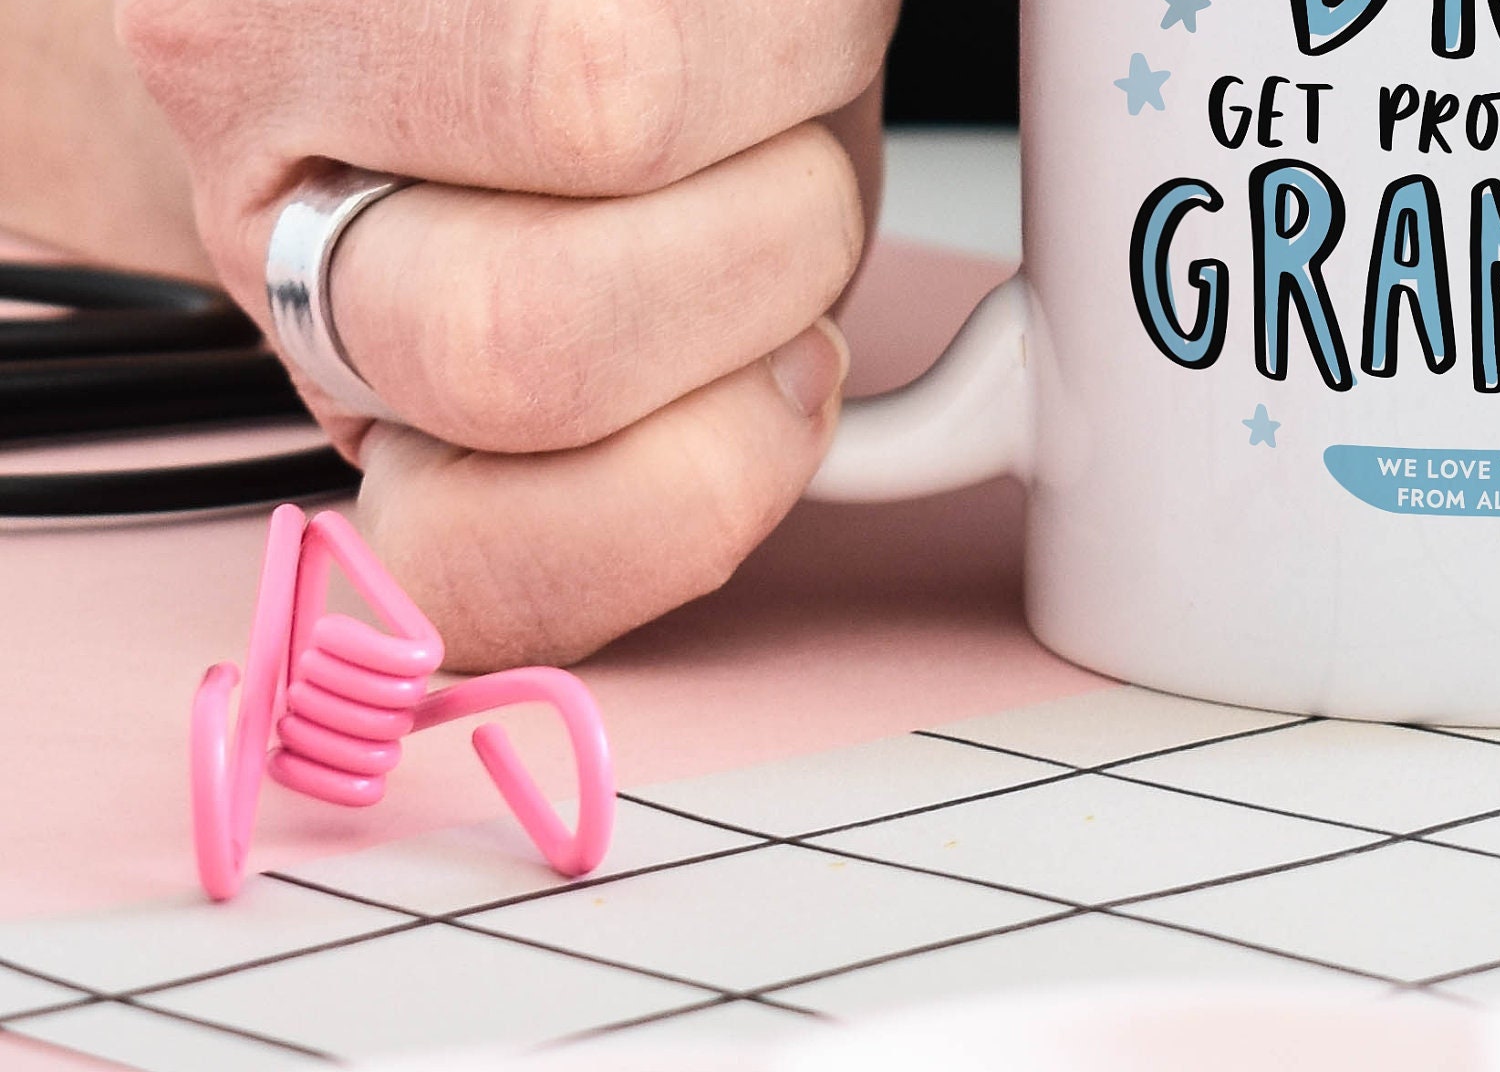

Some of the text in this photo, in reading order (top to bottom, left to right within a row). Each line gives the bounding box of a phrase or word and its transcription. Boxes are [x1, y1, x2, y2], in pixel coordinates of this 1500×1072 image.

[1208, 75, 1333, 149] GET
[1377, 458, 1417, 478] WE
[1427, 459, 1491, 480] LOVE
[1397, 488, 1466, 509] FROM
